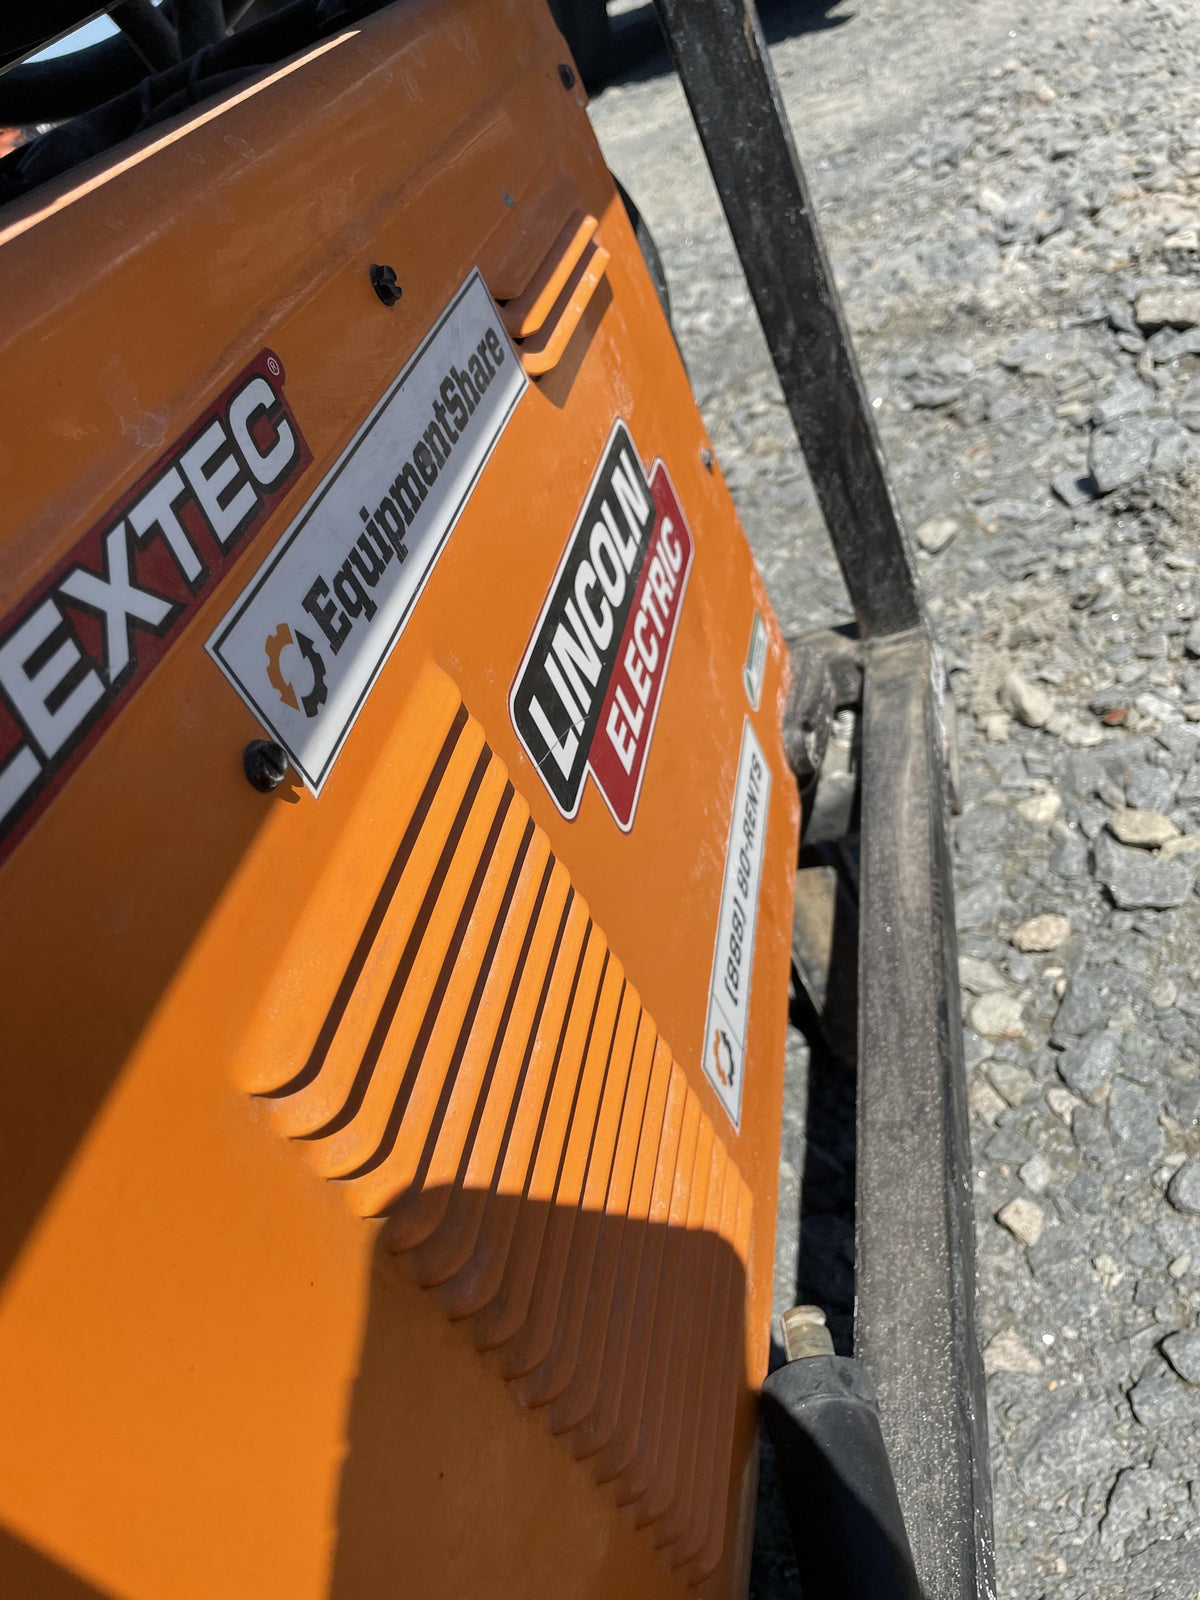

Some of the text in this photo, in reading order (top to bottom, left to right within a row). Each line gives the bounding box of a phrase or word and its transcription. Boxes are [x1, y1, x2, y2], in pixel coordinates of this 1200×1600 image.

[301, 326, 505, 656] EquipmentShare
[528, 448, 651, 781] LINCOLN
[605, 516, 683, 776] ELECTRIC
[724, 896, 746, 1006] (888)
